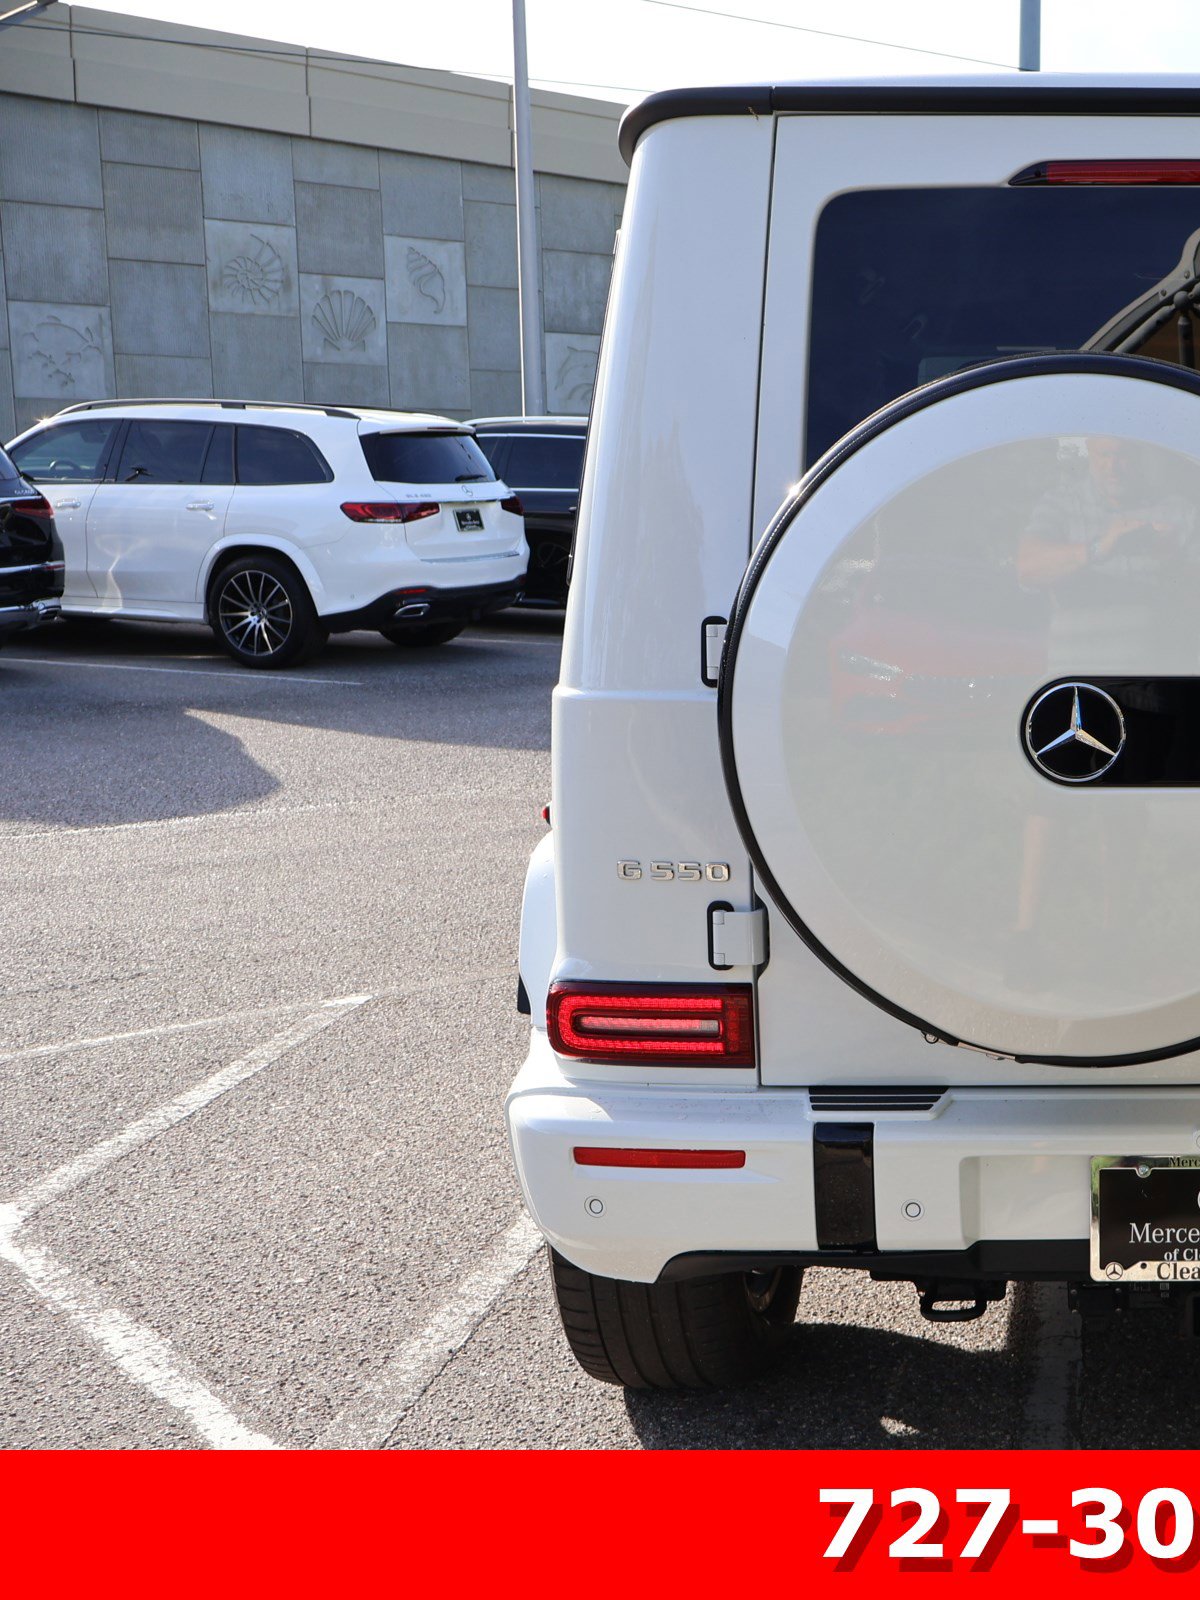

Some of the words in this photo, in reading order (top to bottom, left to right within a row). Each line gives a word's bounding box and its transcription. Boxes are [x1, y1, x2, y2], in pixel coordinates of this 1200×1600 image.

[616, 860, 642, 880] G
[650, 861, 731, 882] 550
[1164, 1248, 1180, 1262] of
